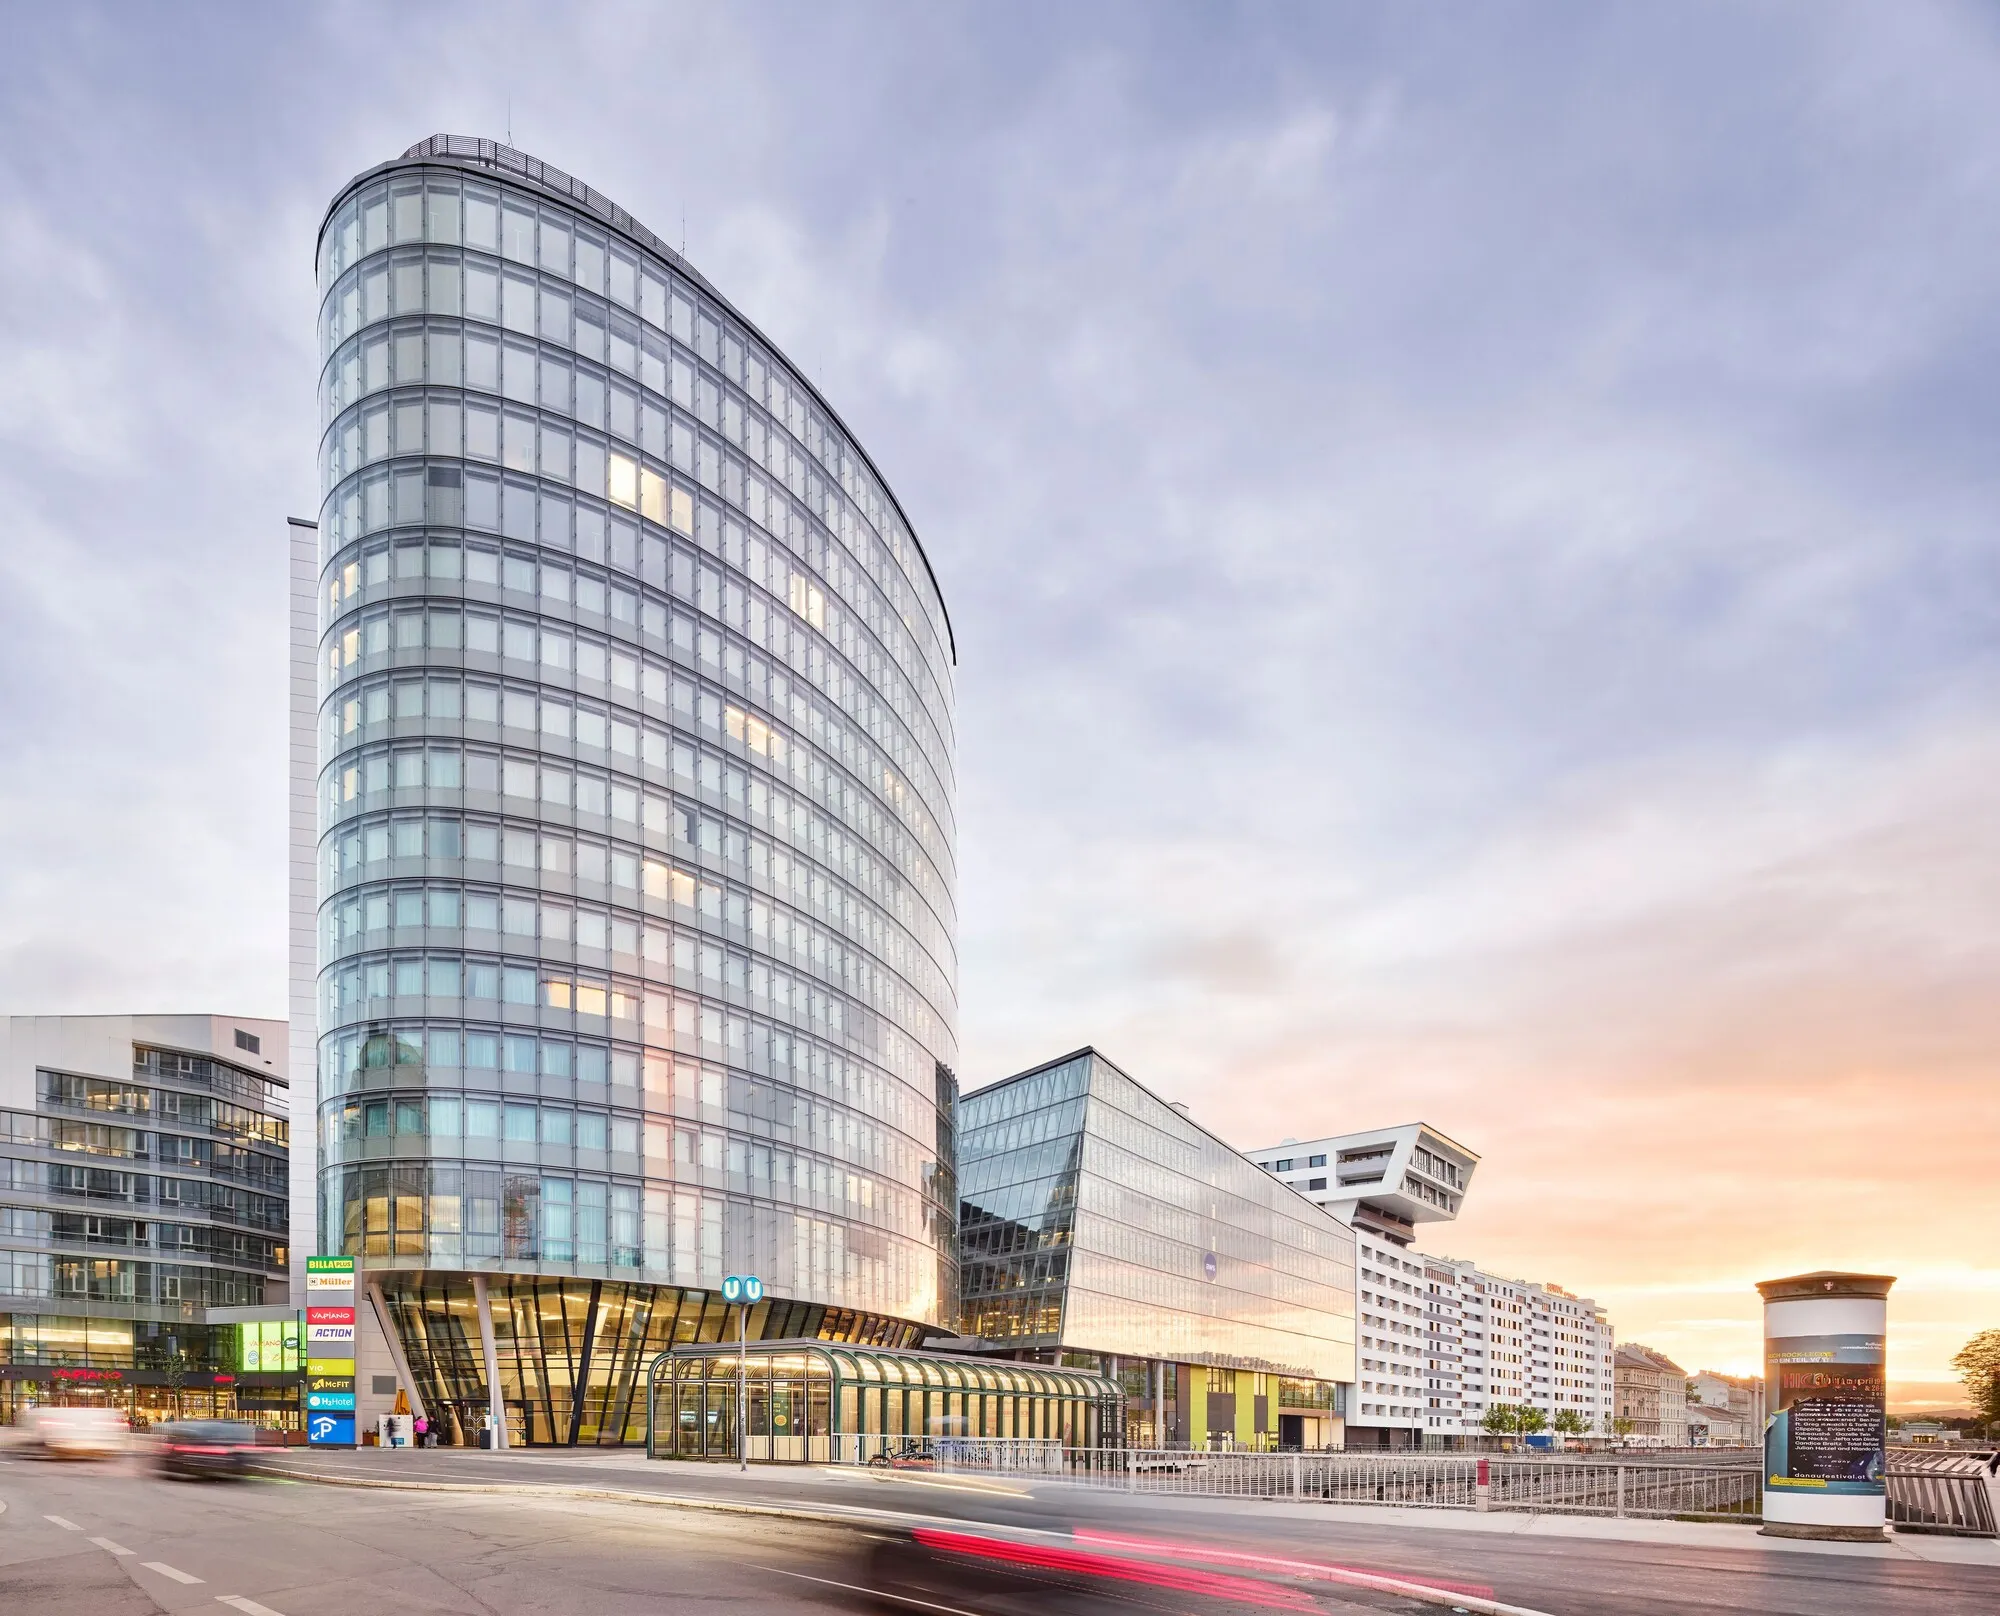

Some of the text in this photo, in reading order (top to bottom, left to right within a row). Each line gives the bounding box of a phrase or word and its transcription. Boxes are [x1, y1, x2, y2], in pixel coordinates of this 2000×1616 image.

[308, 1260, 334, 1268] BILLA
[725, 1280, 739, 1299] U
[747, 1280, 760, 1299] U
[311, 1311, 350, 1320] VAPIANO
[315, 1329, 352, 1337] ACTION
[52, 1369, 122, 1380] VAPIANO
[320, 1422, 332, 1438] P
